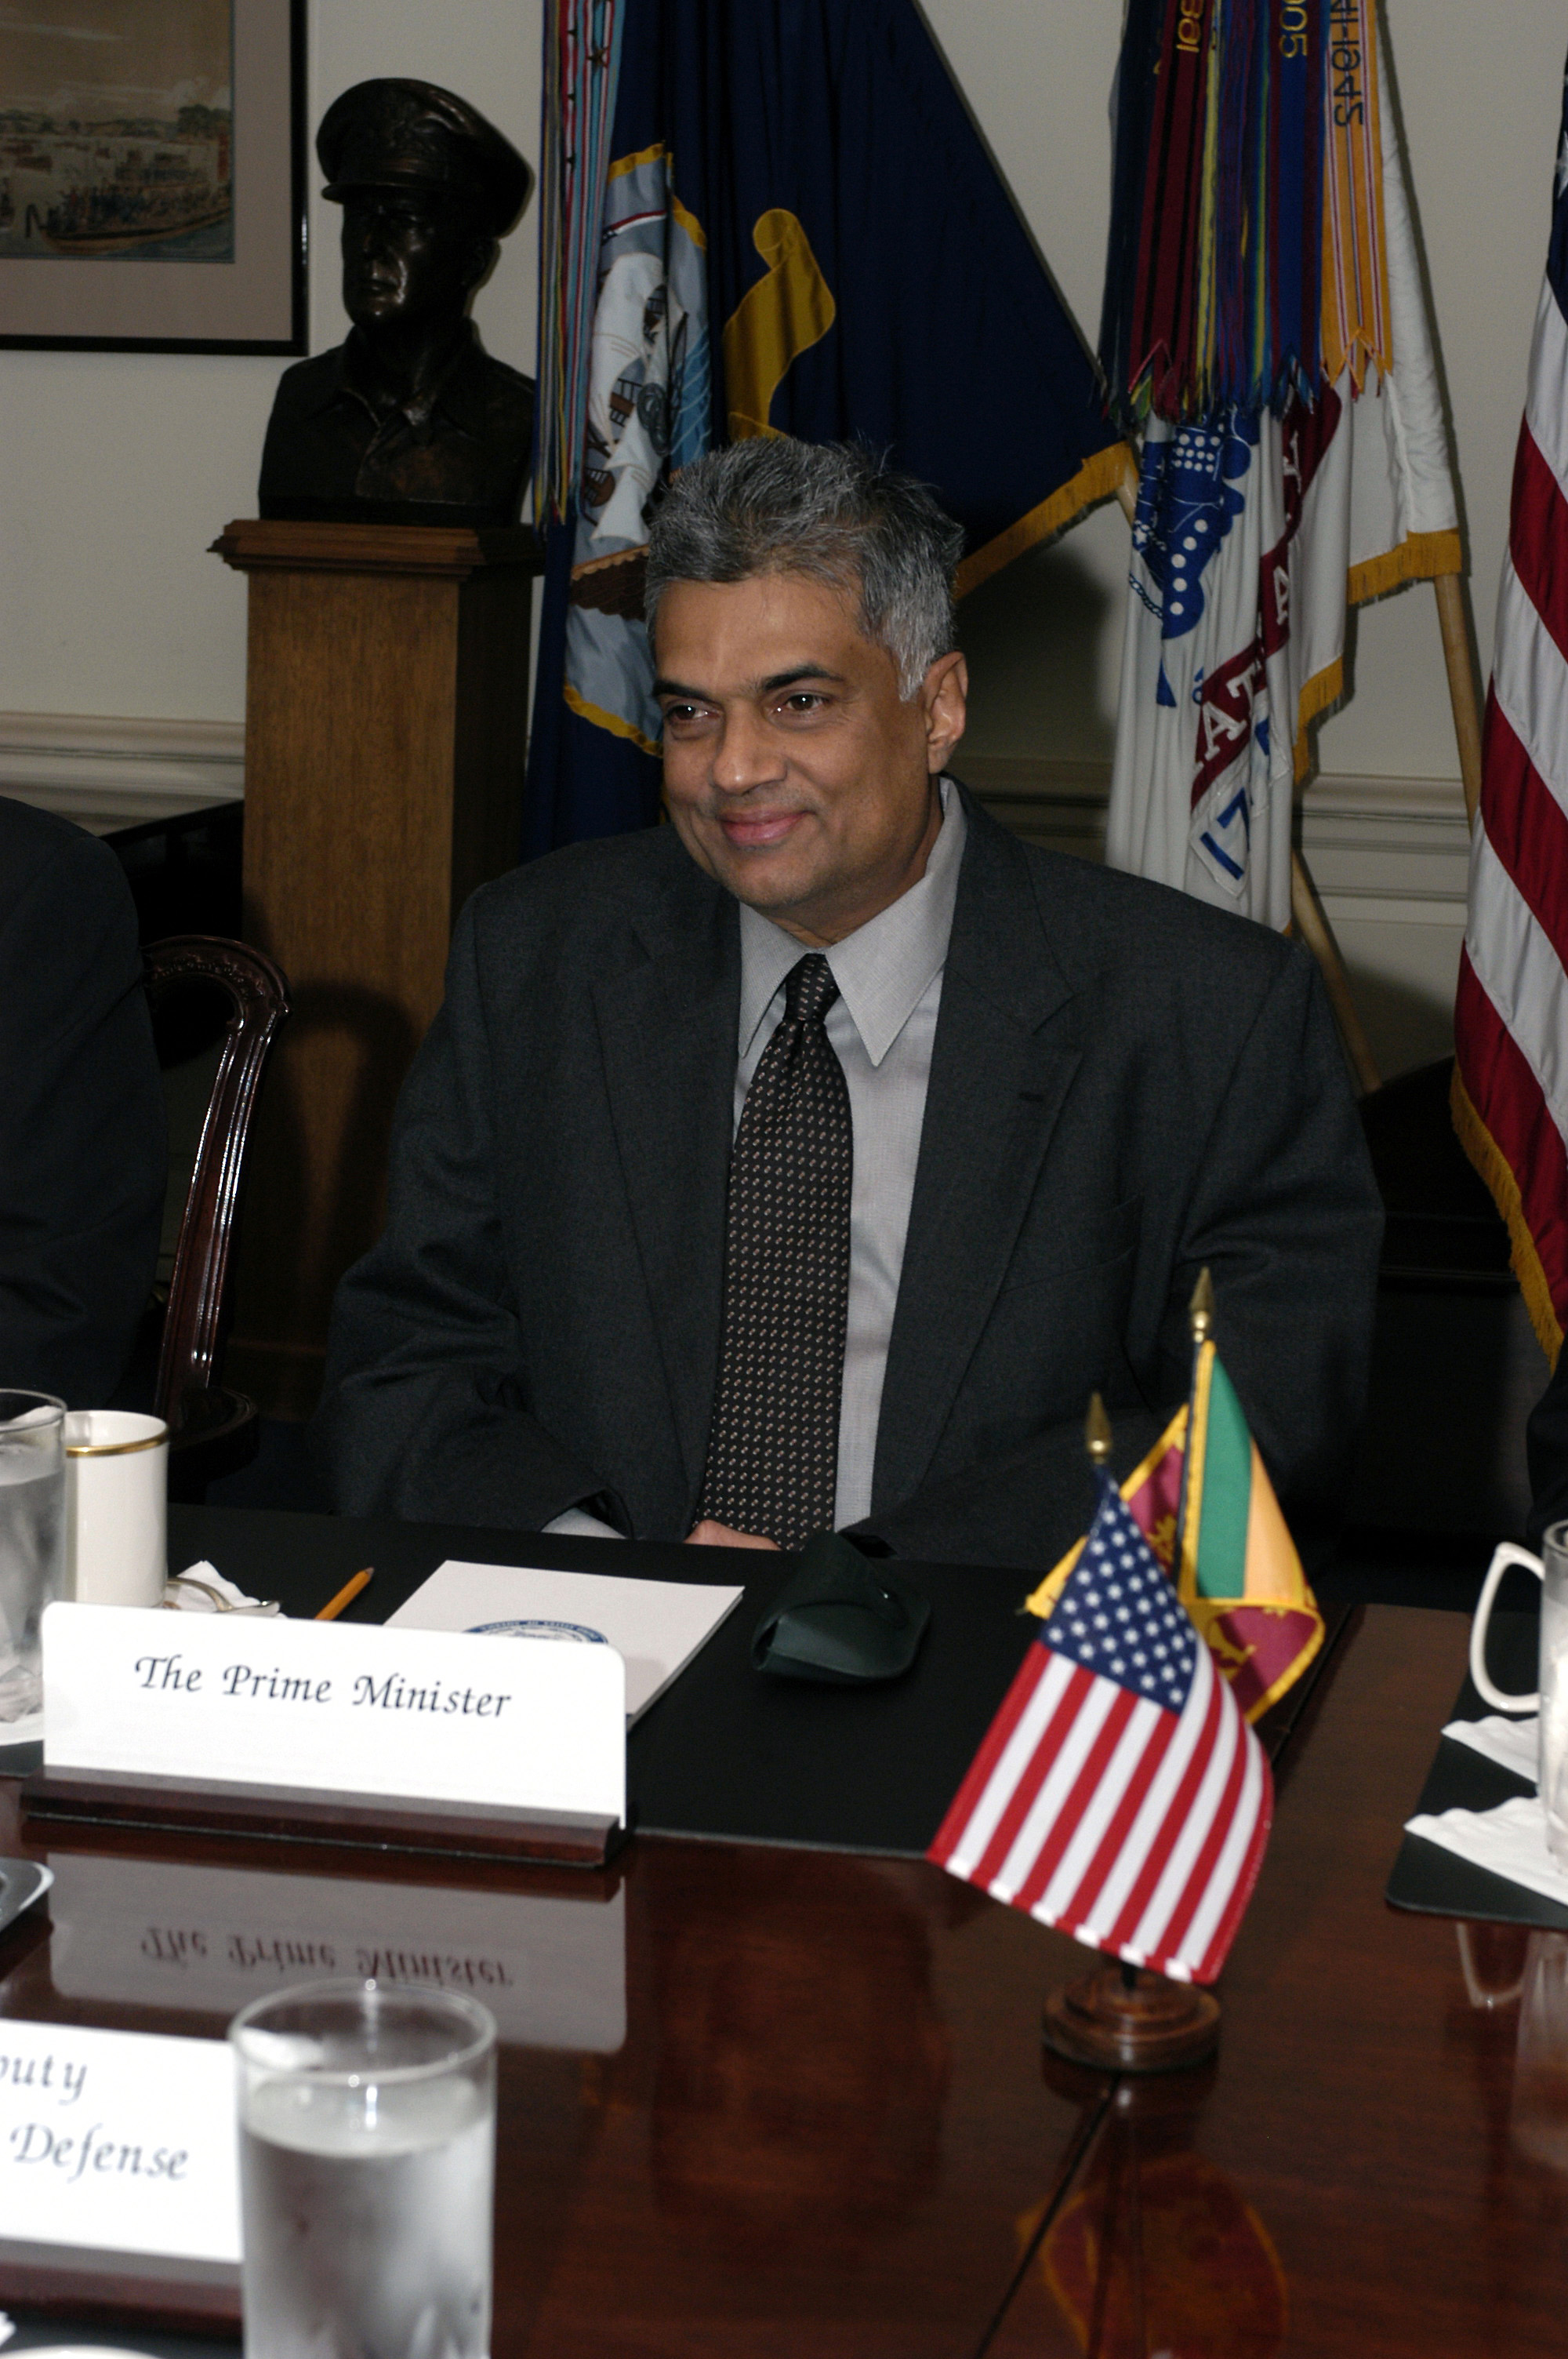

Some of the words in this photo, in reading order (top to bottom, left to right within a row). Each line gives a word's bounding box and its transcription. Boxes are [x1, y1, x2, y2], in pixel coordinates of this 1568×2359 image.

[1279, 0, 1308, 59] 05
[135, 1654, 202, 1692] The
[223, 1664, 332, 1703] Prime
[352, 1673, 512, 1717] Minister
[9, 2121, 188, 2184] Defense
